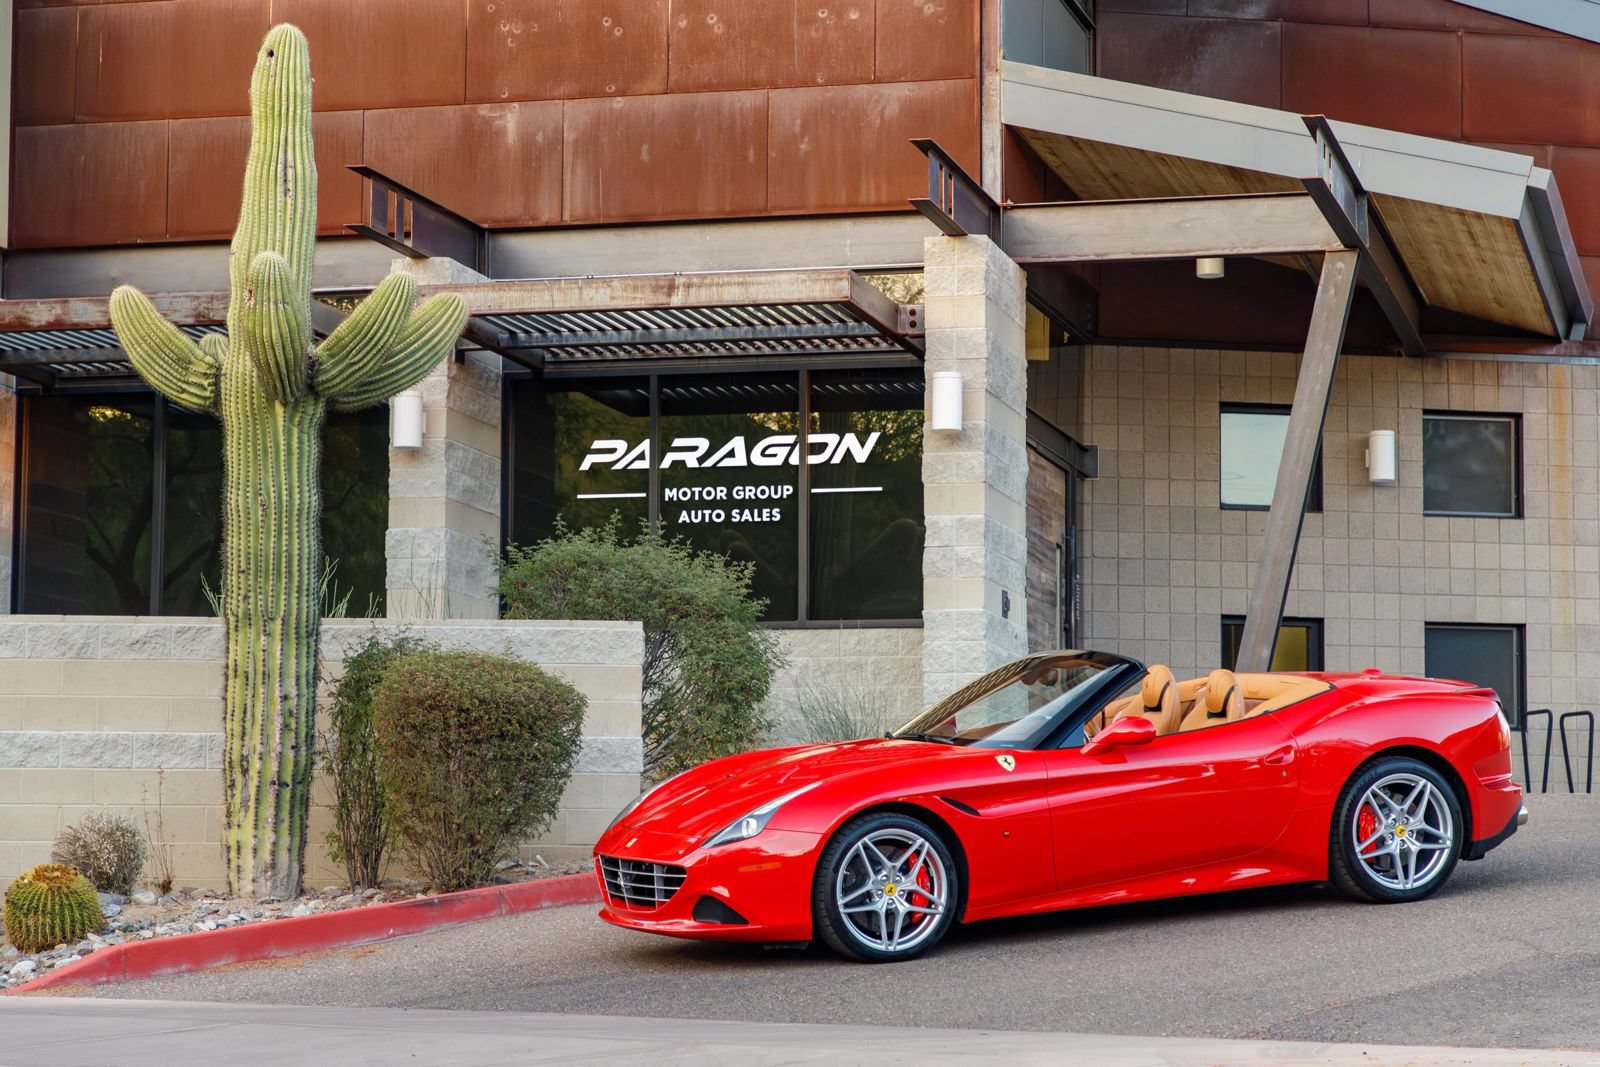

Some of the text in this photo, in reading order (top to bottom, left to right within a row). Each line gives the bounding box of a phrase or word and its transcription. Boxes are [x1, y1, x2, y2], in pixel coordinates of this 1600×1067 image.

[579, 432, 881, 471] PARAGON
[664, 485, 793, 501] MOTOR GROUP
[678, 508, 781, 523] AUTO SALES
